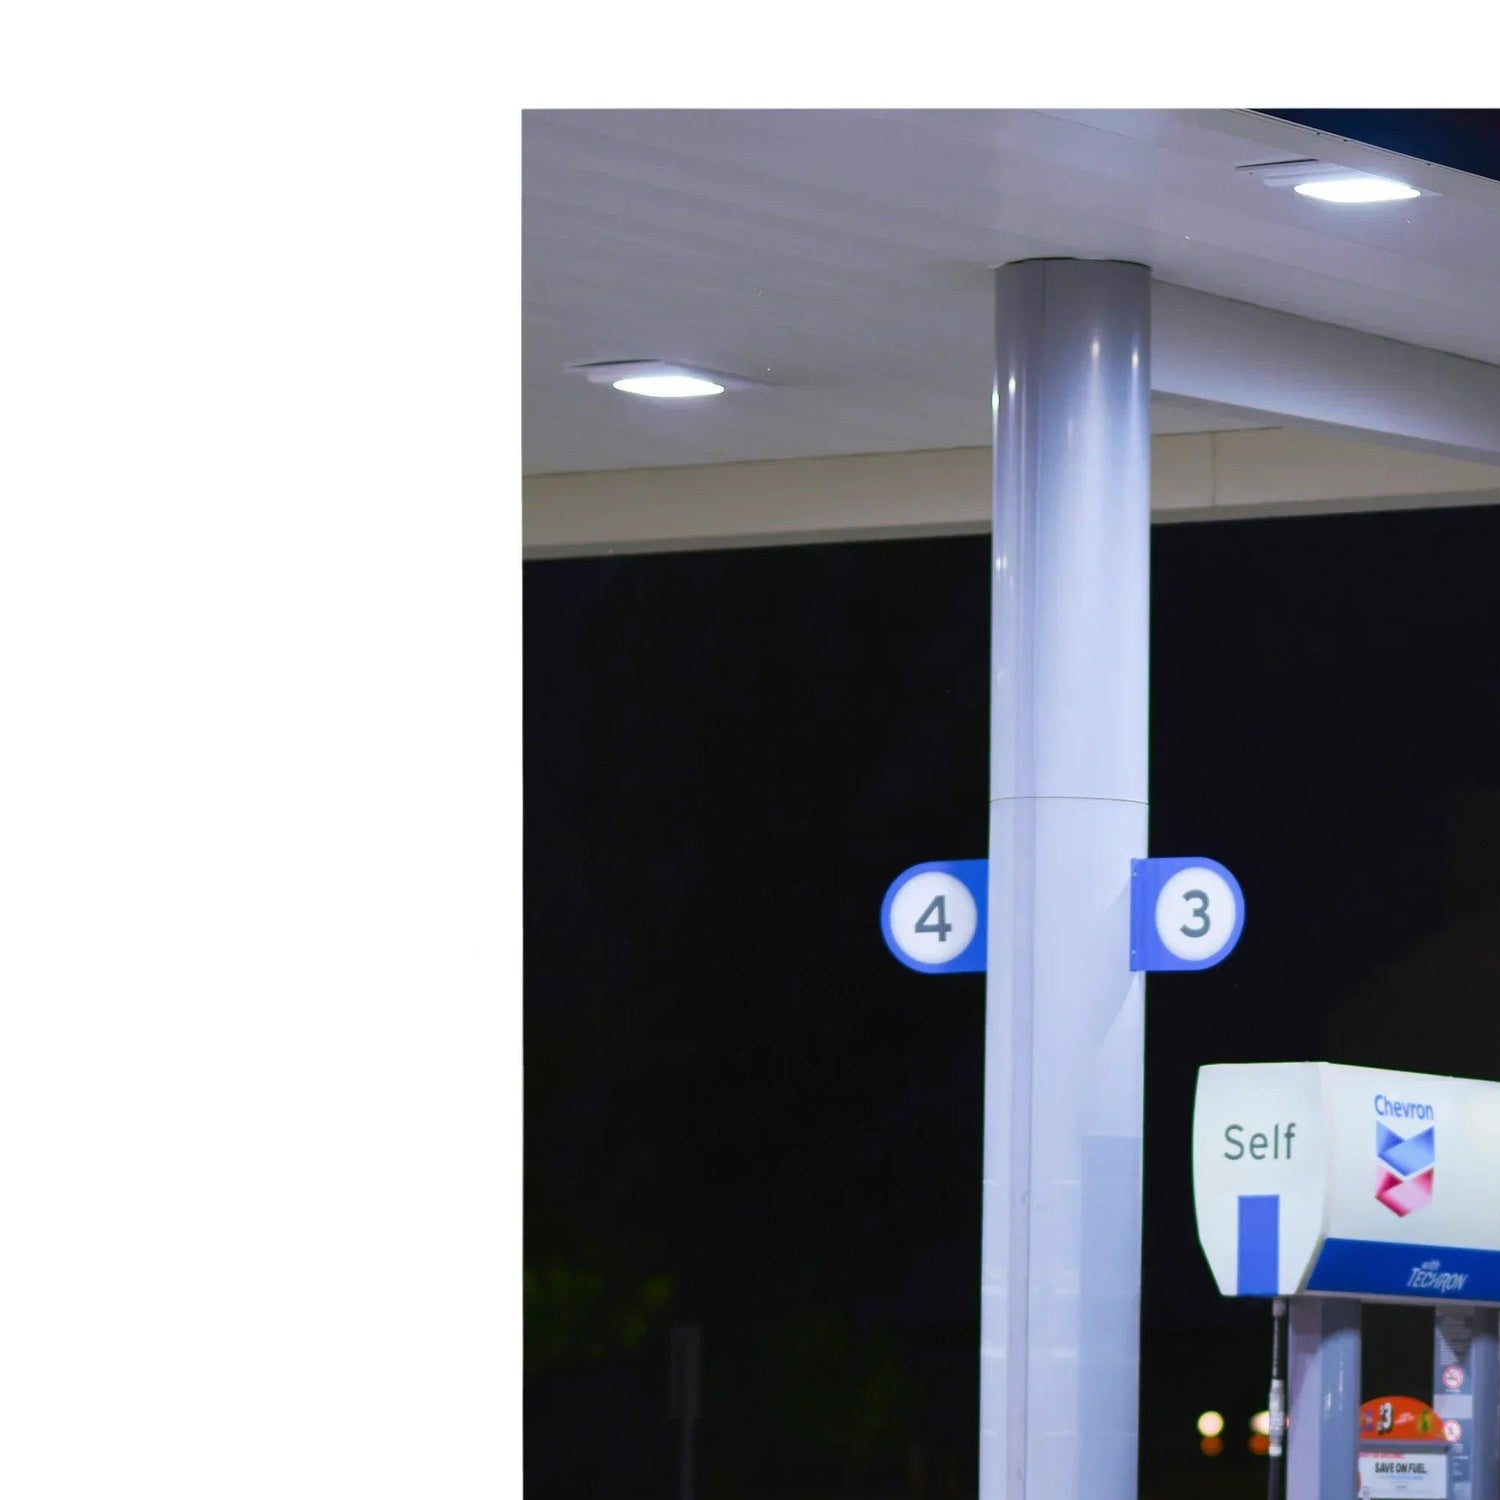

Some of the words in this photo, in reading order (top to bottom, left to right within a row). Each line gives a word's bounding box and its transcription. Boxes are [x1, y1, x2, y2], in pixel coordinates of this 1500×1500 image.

[914, 895, 952, 942] 4
[1179, 889, 1211, 938] 3
[1374, 1094, 1434, 1120] Chevron
[1224, 1122, 1297, 1161] Self
[1375, 1462, 1394, 1473] SAVE
[1396, 1463, 1407, 1473] ON
